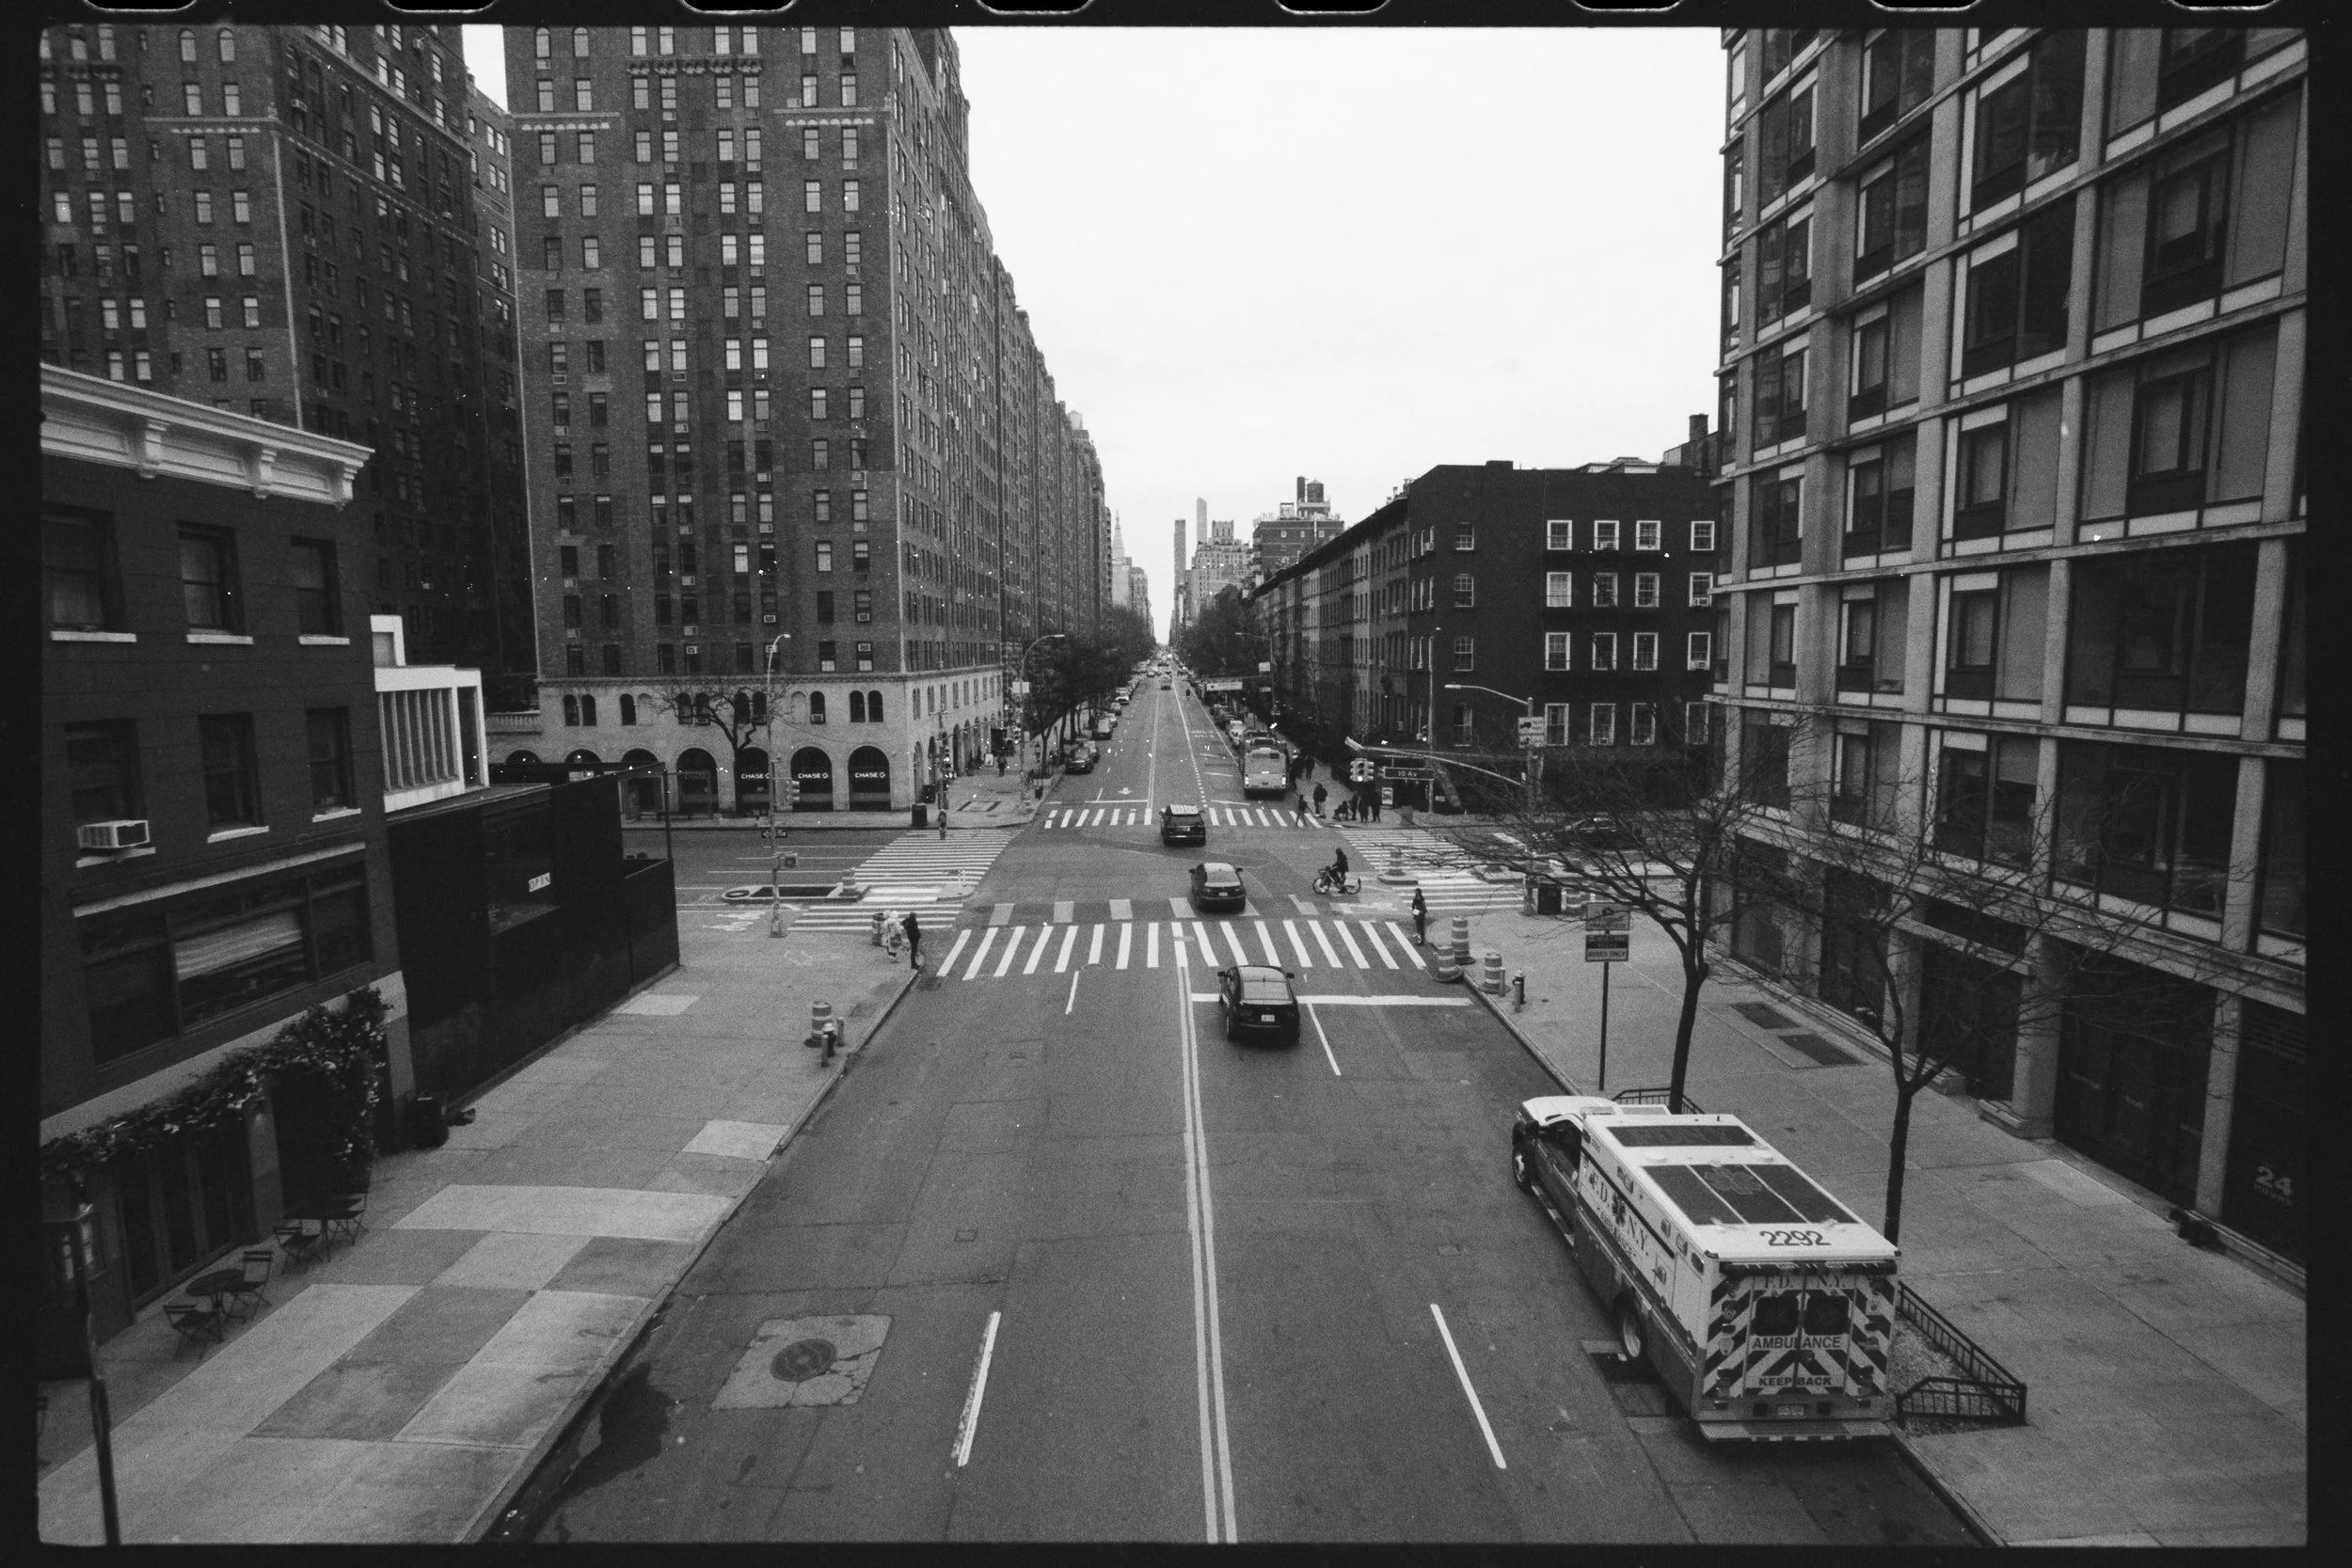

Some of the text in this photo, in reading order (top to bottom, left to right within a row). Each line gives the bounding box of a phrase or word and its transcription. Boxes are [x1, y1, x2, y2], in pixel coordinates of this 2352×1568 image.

[529, 876, 550, 890] OPEN
[2255, 1165, 2293, 1196] 24
[1759, 1230, 1832, 1246] 2292
[1764, 1275, 1847, 1290] F.D. N.Y.
[1752, 1337, 1841, 1350] AMBULANCE
[1758, 1376, 1832, 1386] KEEP BACK
